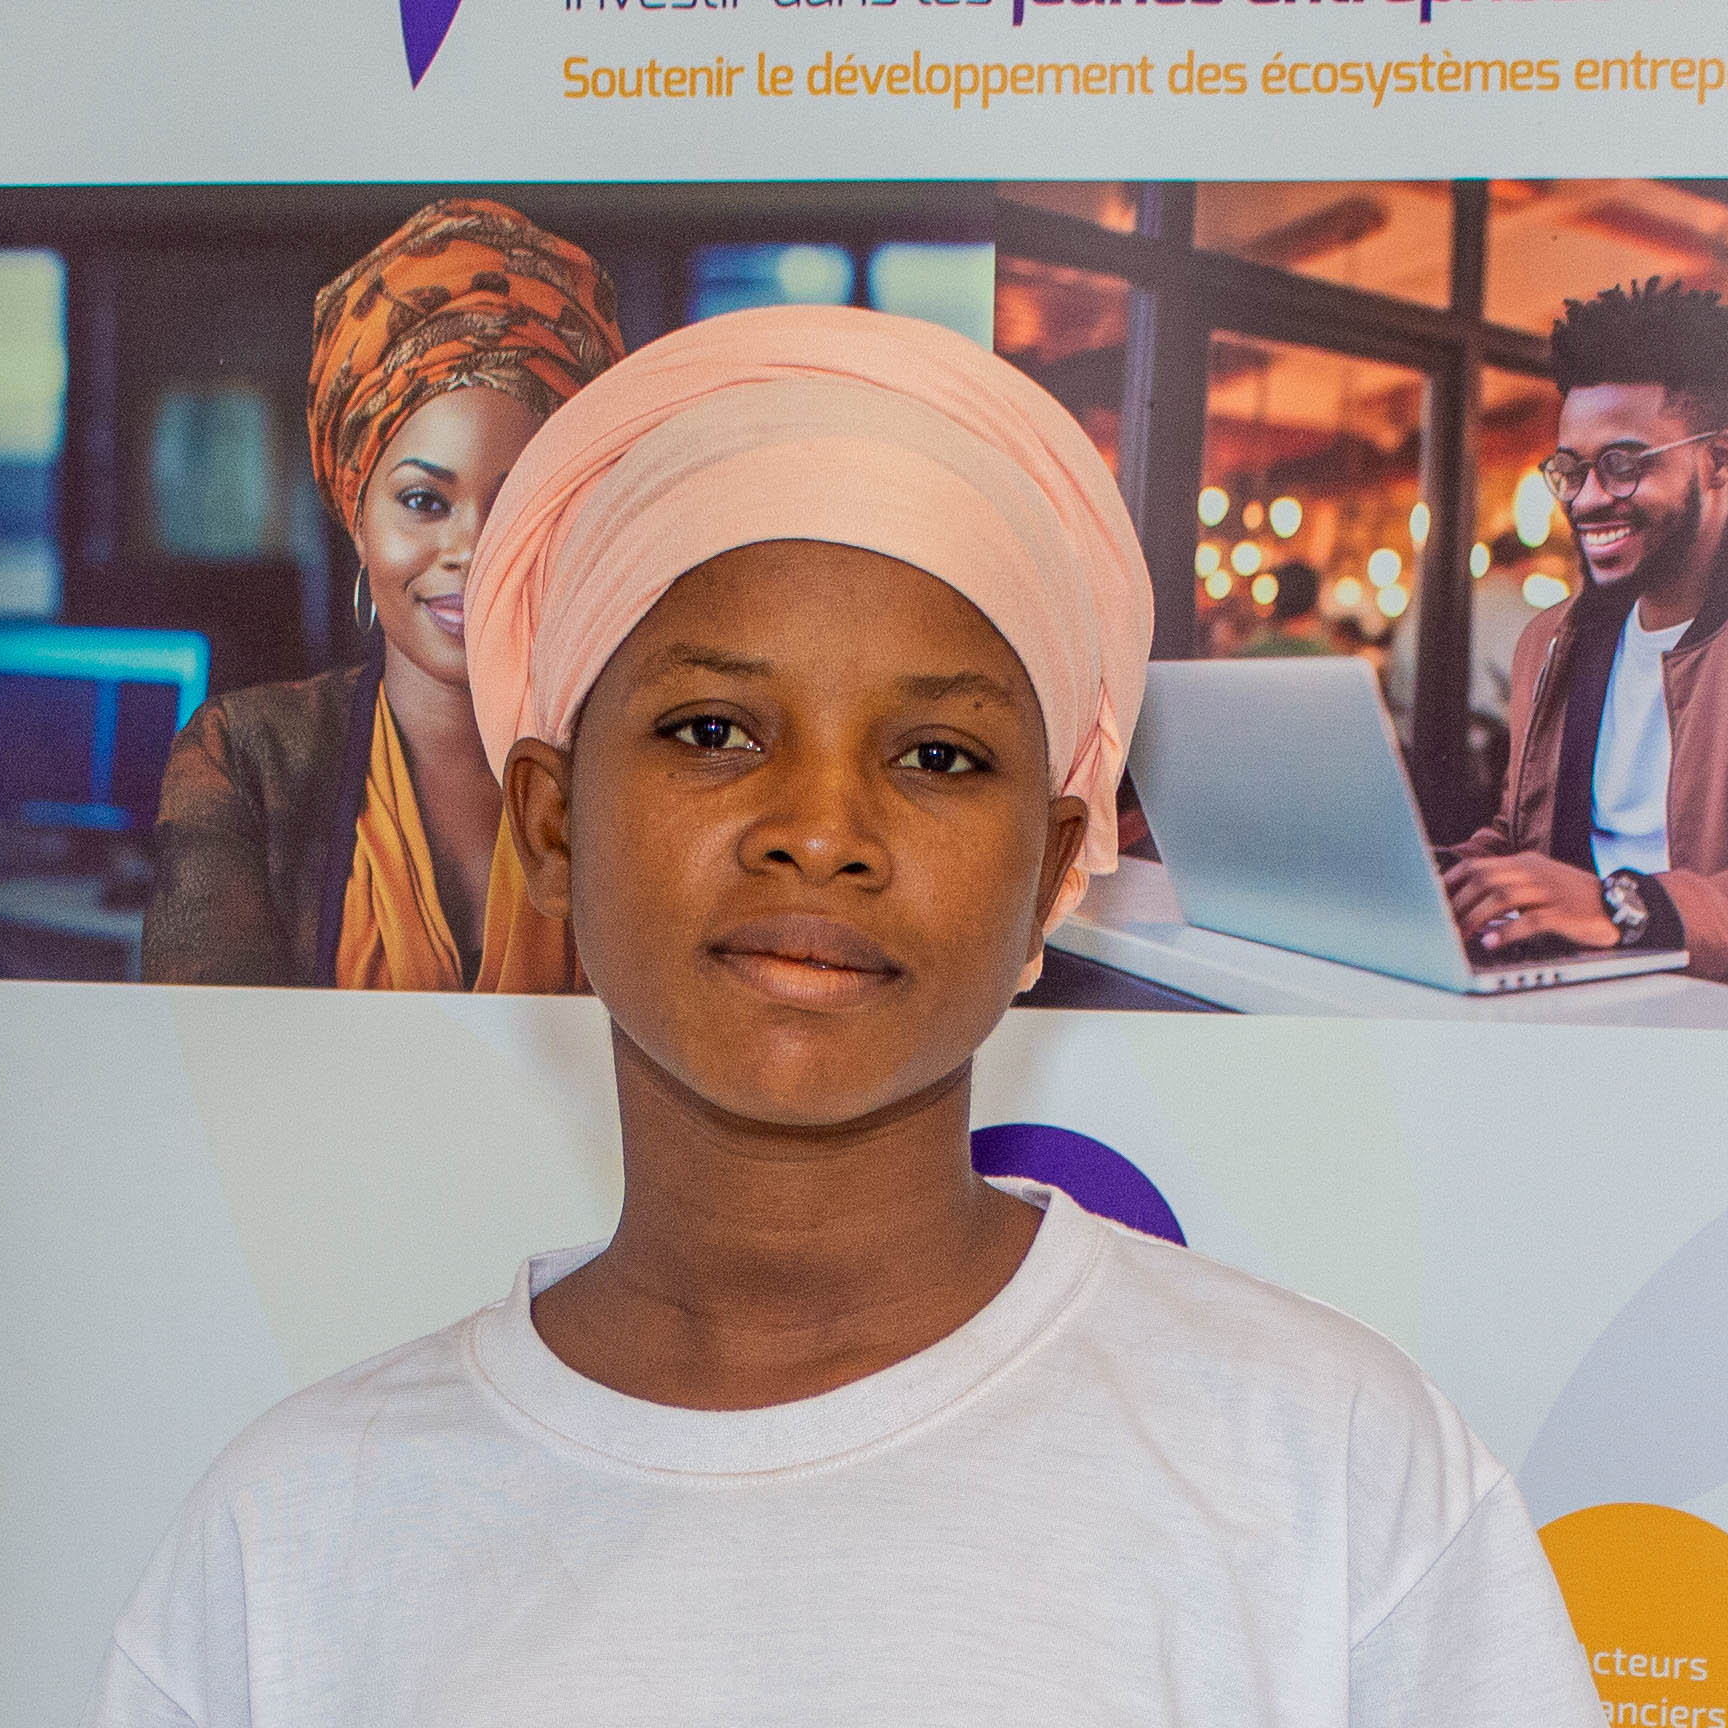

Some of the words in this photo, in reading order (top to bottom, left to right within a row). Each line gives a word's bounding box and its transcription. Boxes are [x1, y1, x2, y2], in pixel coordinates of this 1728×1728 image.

[562, 55, 745, 99] Soutenir
[758, 52, 794, 96] le
[806, 49, 1154, 109] développement
[1167, 49, 1248, 96] des
[1261, 50, 1560, 108] écosystèmes
[1591, 1647, 1708, 1681] cteurs
